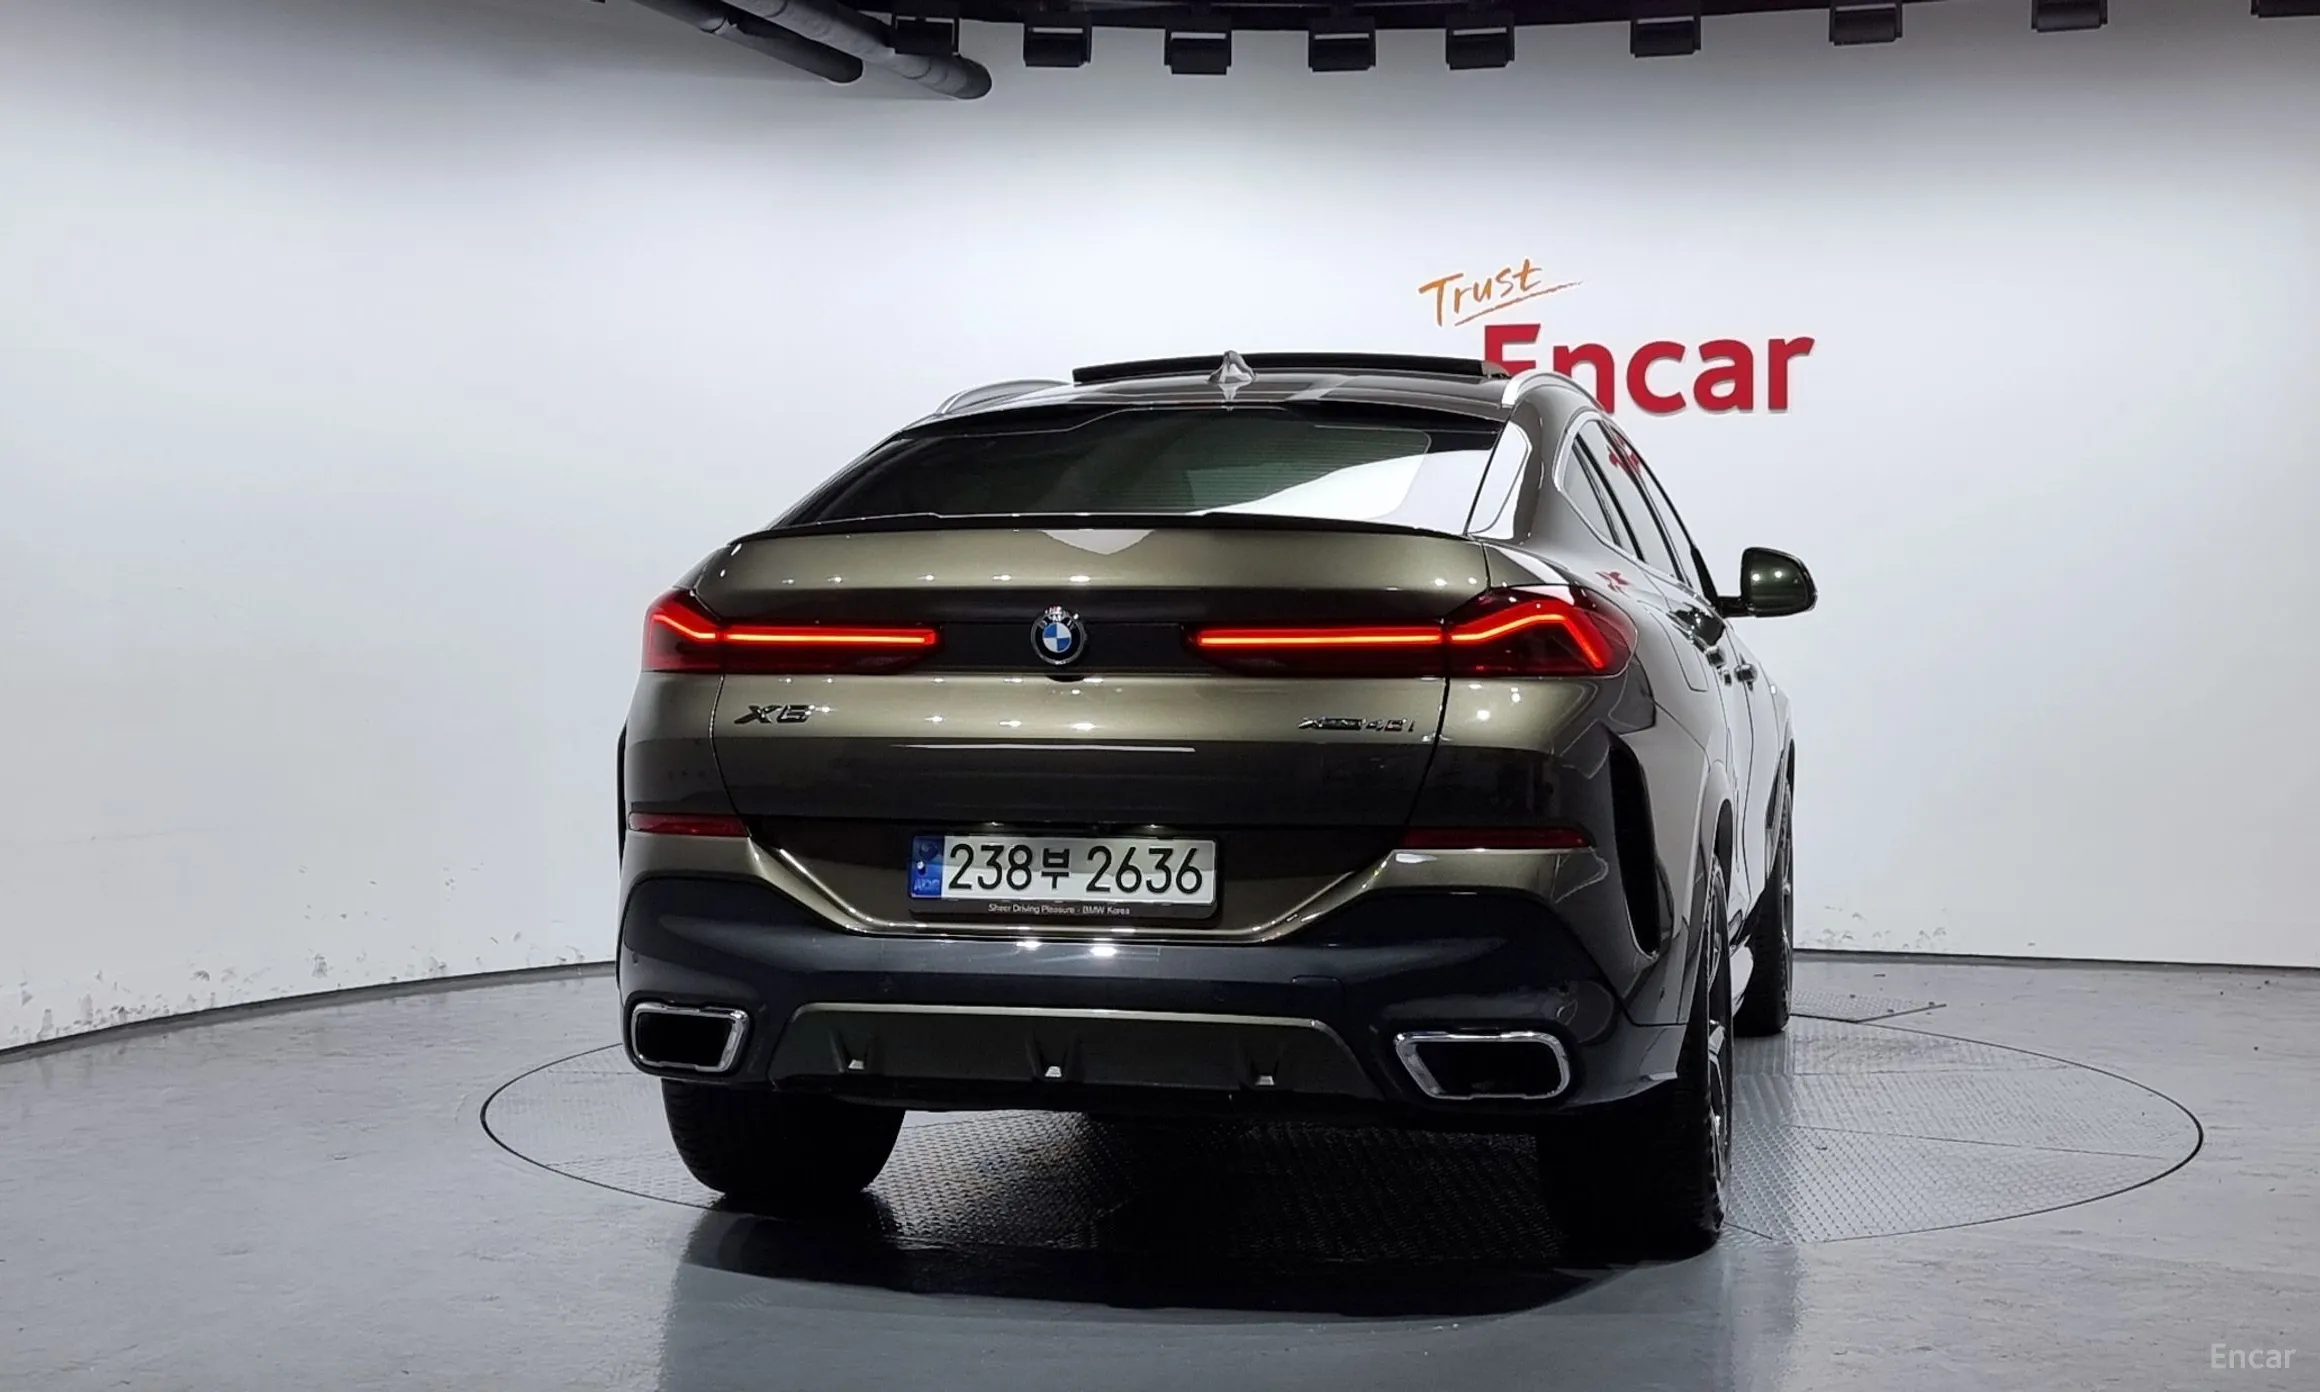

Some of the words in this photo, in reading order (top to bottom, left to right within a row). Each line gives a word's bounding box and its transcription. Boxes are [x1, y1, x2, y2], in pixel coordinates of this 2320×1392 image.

[1419, 258, 1544, 327] Trust
[1484, 323, 1815, 415] Encar
[949, 843, 1070, 890] 238부
[1086, 845, 1203, 894] 2636
[1012, 904, 1040, 916] Driving
[1041, 905, 1076, 916] Pleasure
[1082, 905, 1105, 916] BMW
[1107, 906, 1130, 917] Korea
